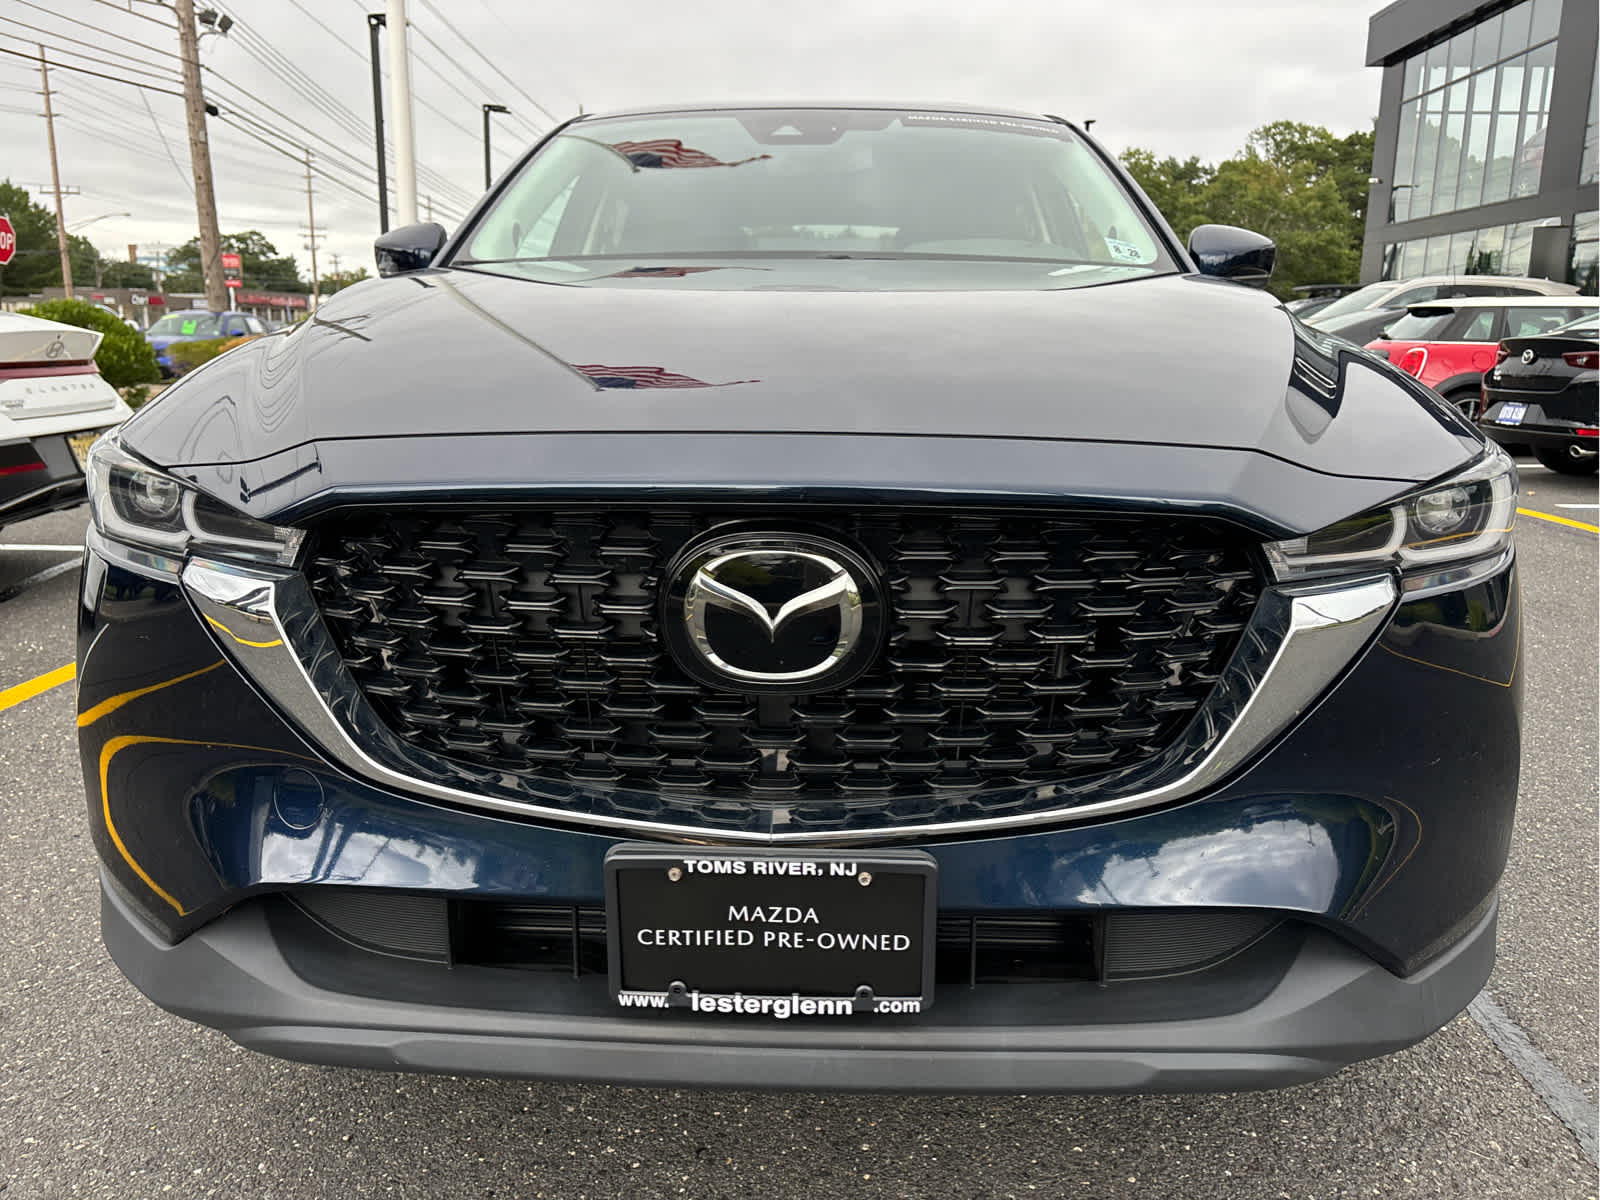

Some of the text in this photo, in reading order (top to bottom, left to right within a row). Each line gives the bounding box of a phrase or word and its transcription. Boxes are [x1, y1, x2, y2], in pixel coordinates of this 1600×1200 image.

[683, 859, 857, 877] TOMS RIVER, NJ
[727, 905, 819, 924] MAZDA
[637, 928, 911, 951] CERTIFIED PRE-OWNED
[618, 990, 921, 1018] www. lesterglenn .com
